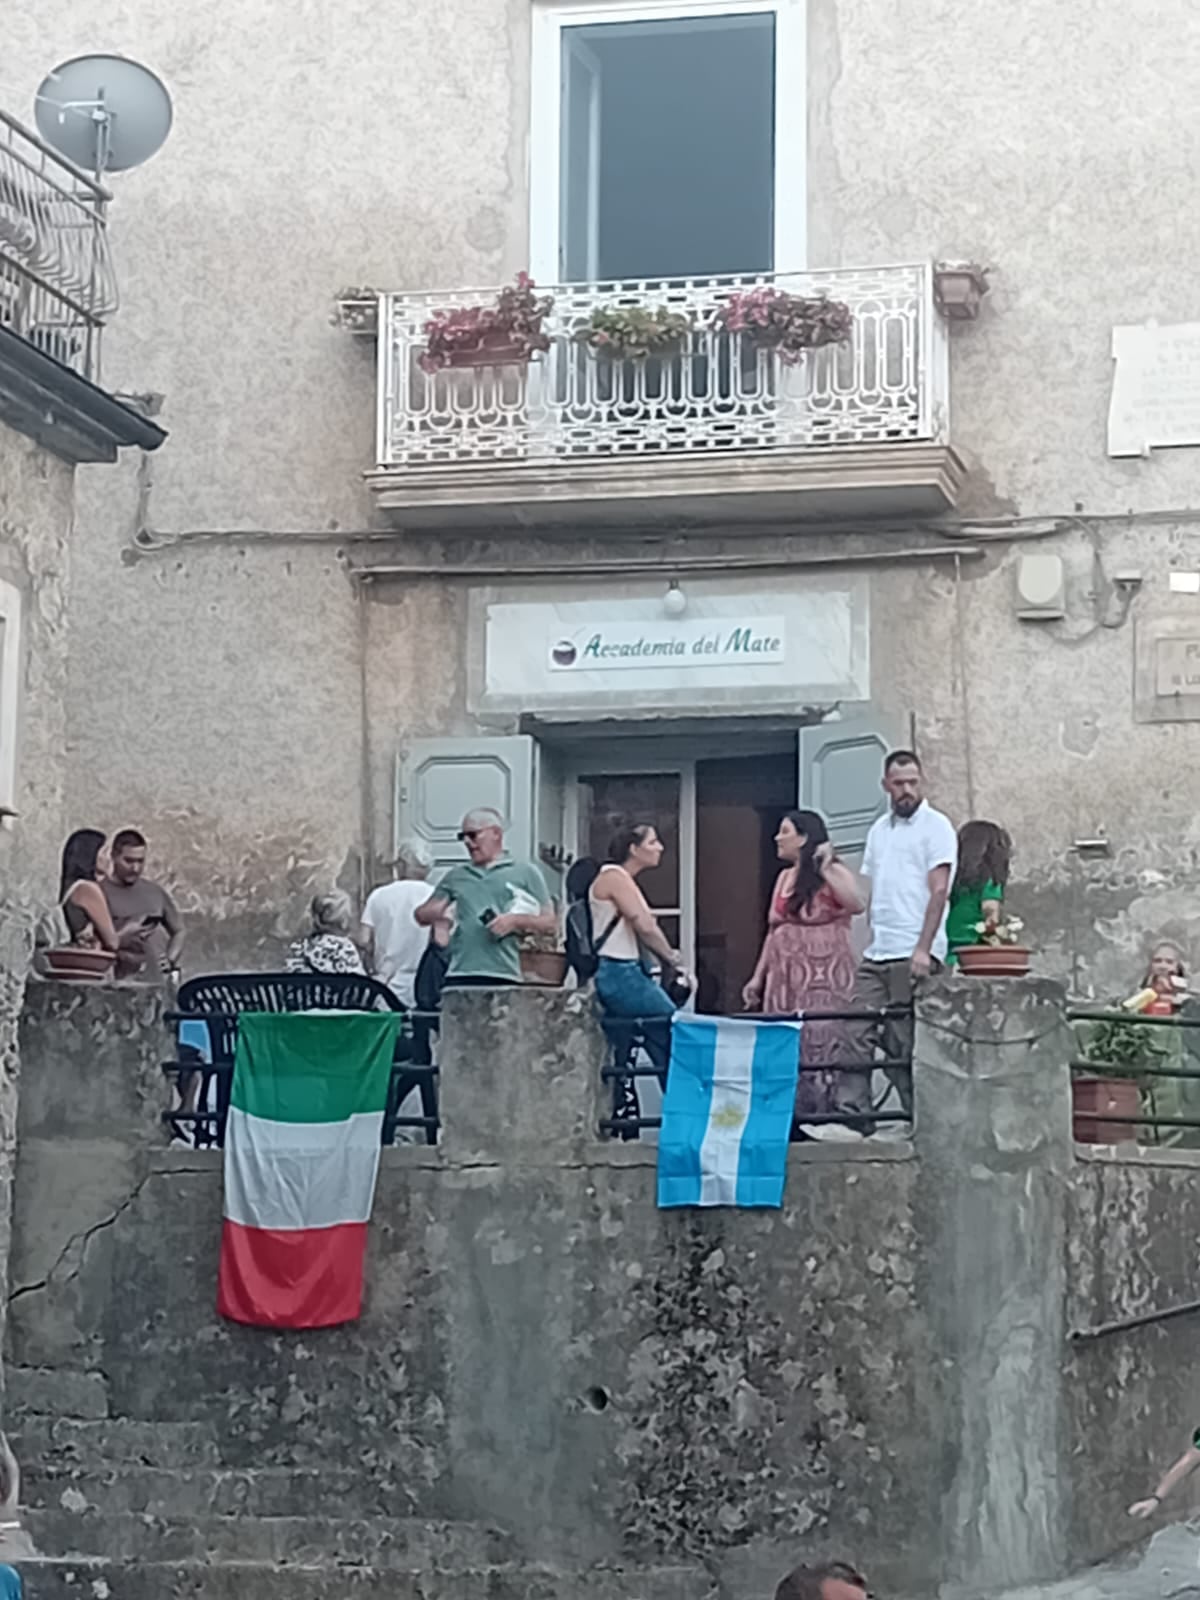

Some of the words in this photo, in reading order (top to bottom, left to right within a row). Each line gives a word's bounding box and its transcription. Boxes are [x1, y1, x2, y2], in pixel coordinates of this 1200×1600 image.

[583, 633, 685, 658] Accademia
[692, 634, 719, 655] del
[723, 627, 781, 653] Mate
